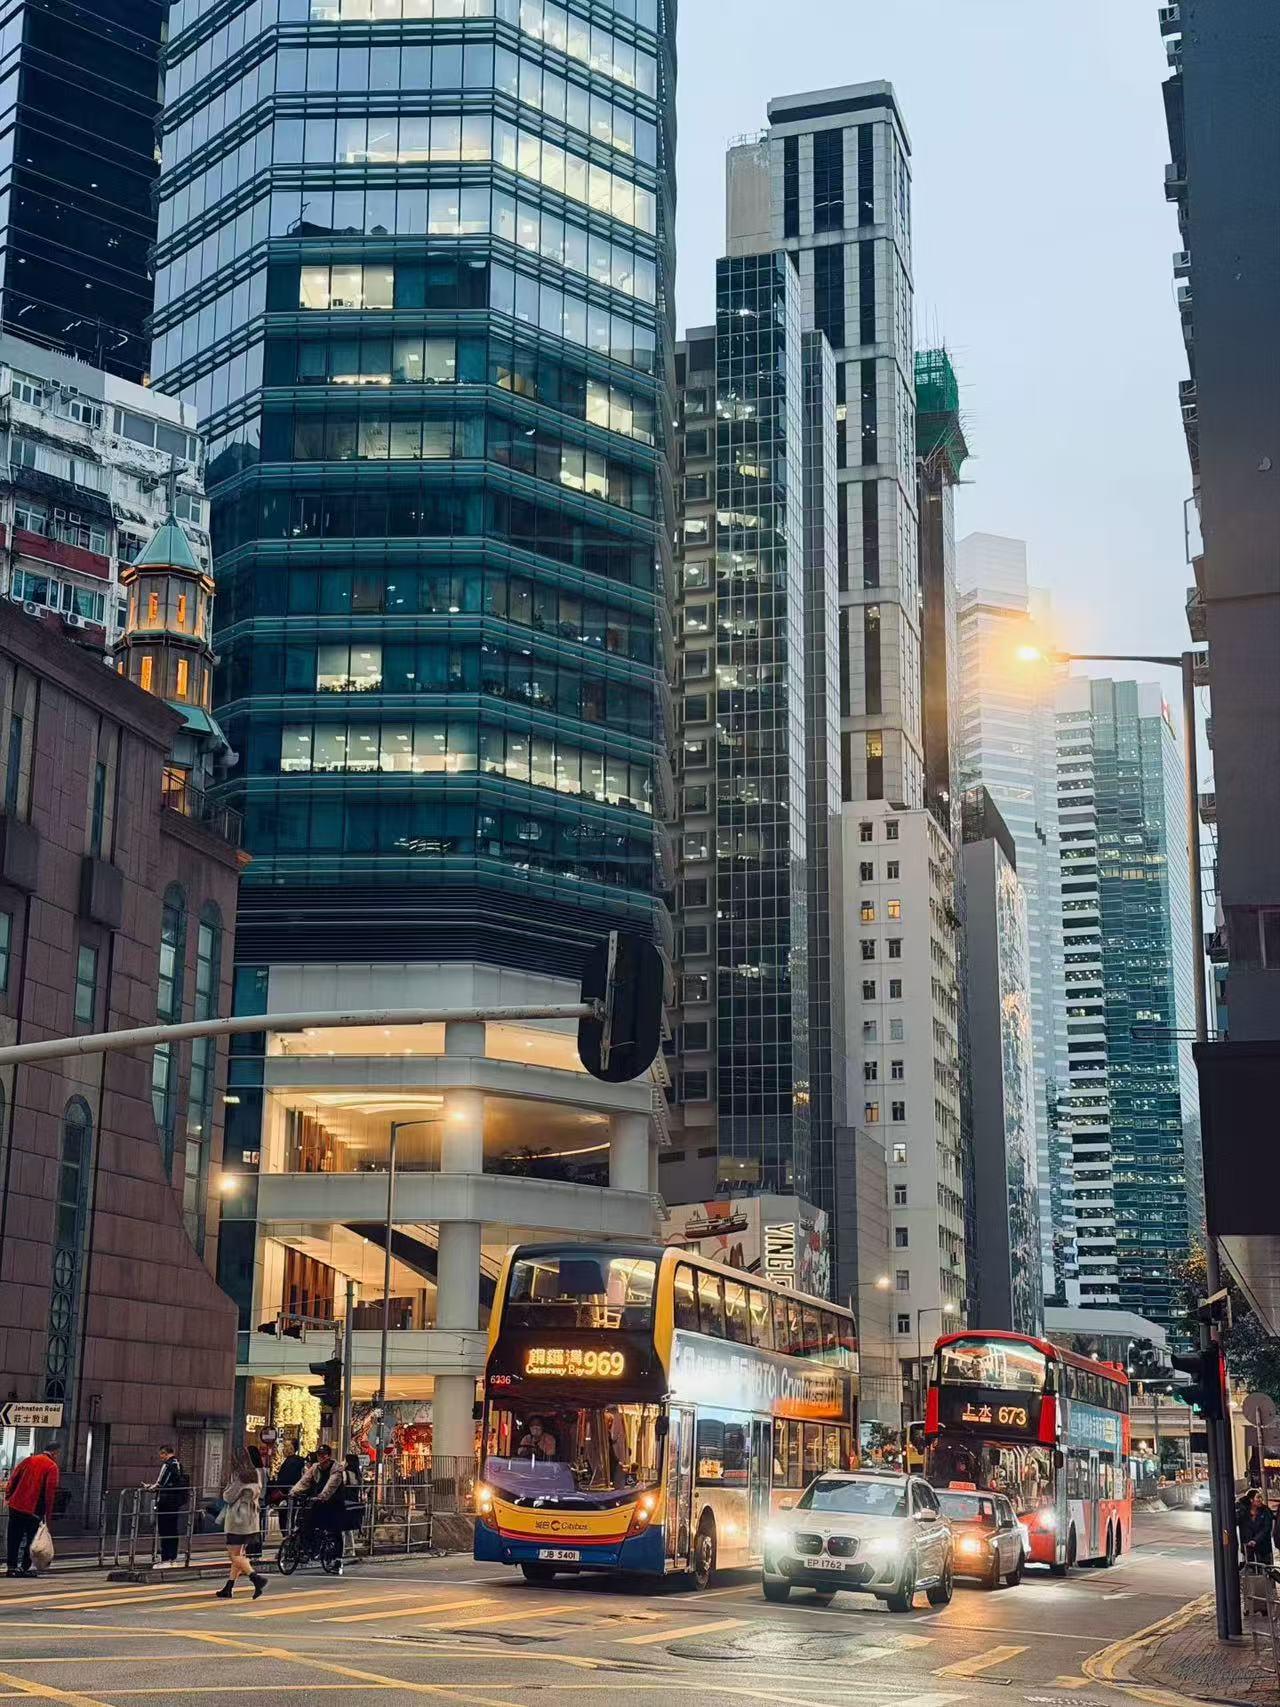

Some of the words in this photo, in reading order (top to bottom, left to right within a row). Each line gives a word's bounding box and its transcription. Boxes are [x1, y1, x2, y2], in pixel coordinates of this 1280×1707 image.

[765, 1222, 795, 1270] YING
[568, 1364, 585, 1377] Bay
[584, 1350, 624, 1376] 969
[962, 1403, 992, 1417] 上水
[998, 1406, 1027, 1426] 673
[557, 1551, 576, 1560] 5401
[807, 1558, 819, 1568] EP
[821, 1560, 842, 1570] 1762
